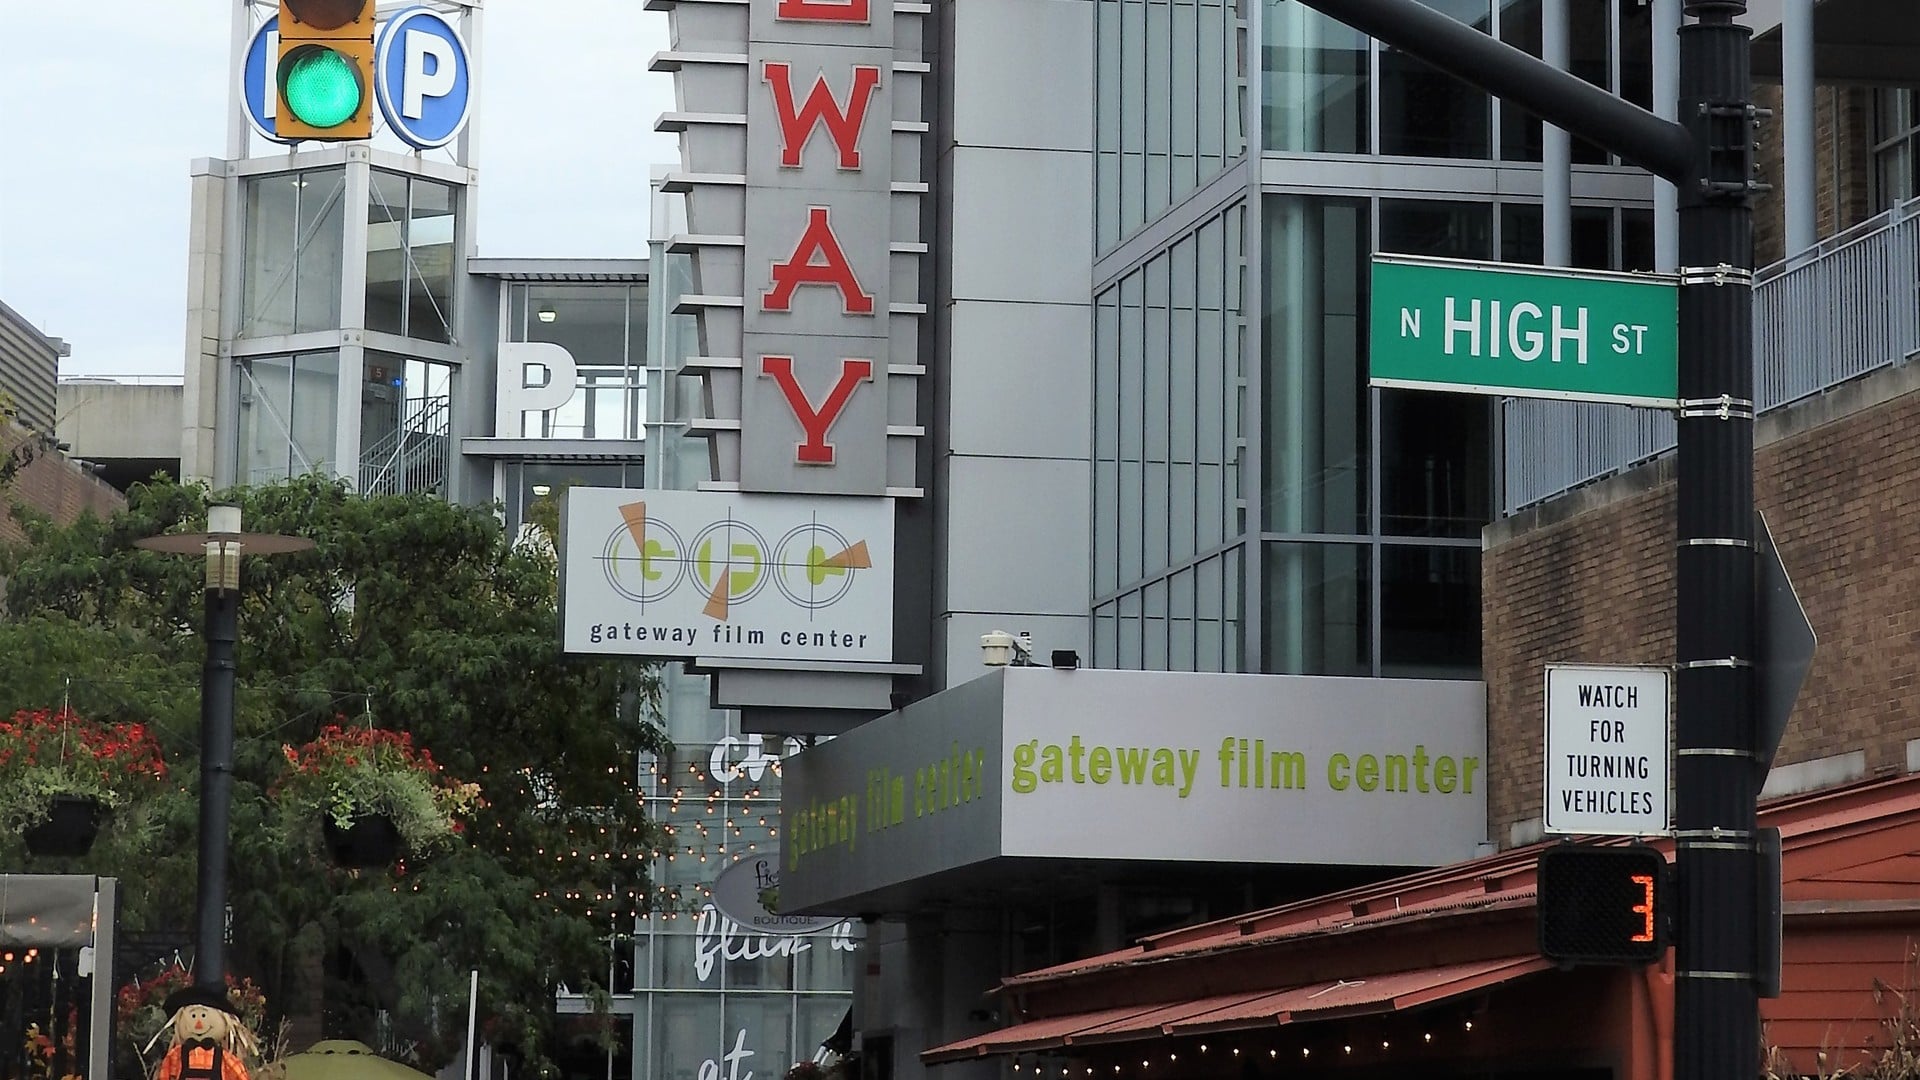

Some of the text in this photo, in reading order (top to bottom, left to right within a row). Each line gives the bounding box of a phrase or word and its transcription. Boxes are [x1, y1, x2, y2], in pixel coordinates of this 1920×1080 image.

[402, 29, 457, 120] P
[761, 0, 883, 466] WAY
[1400, 296, 1648, 365] N HIGH ST
[495, 342, 578, 439] P
[590, 623, 868, 648] gateway film center
[1578, 684, 1639, 709] WATCH
[1590, 720, 1625, 743] FOR
[1011, 735, 1480, 799] gateway film center
[1567, 754, 1649, 779] TURNING
[788, 740, 985, 873] gateway film center
[1562, 789, 1653, 815] VEHICLES
[753, 915, 813, 926] BOUTIQUE
[1631, 875, 1654, 942] 3
